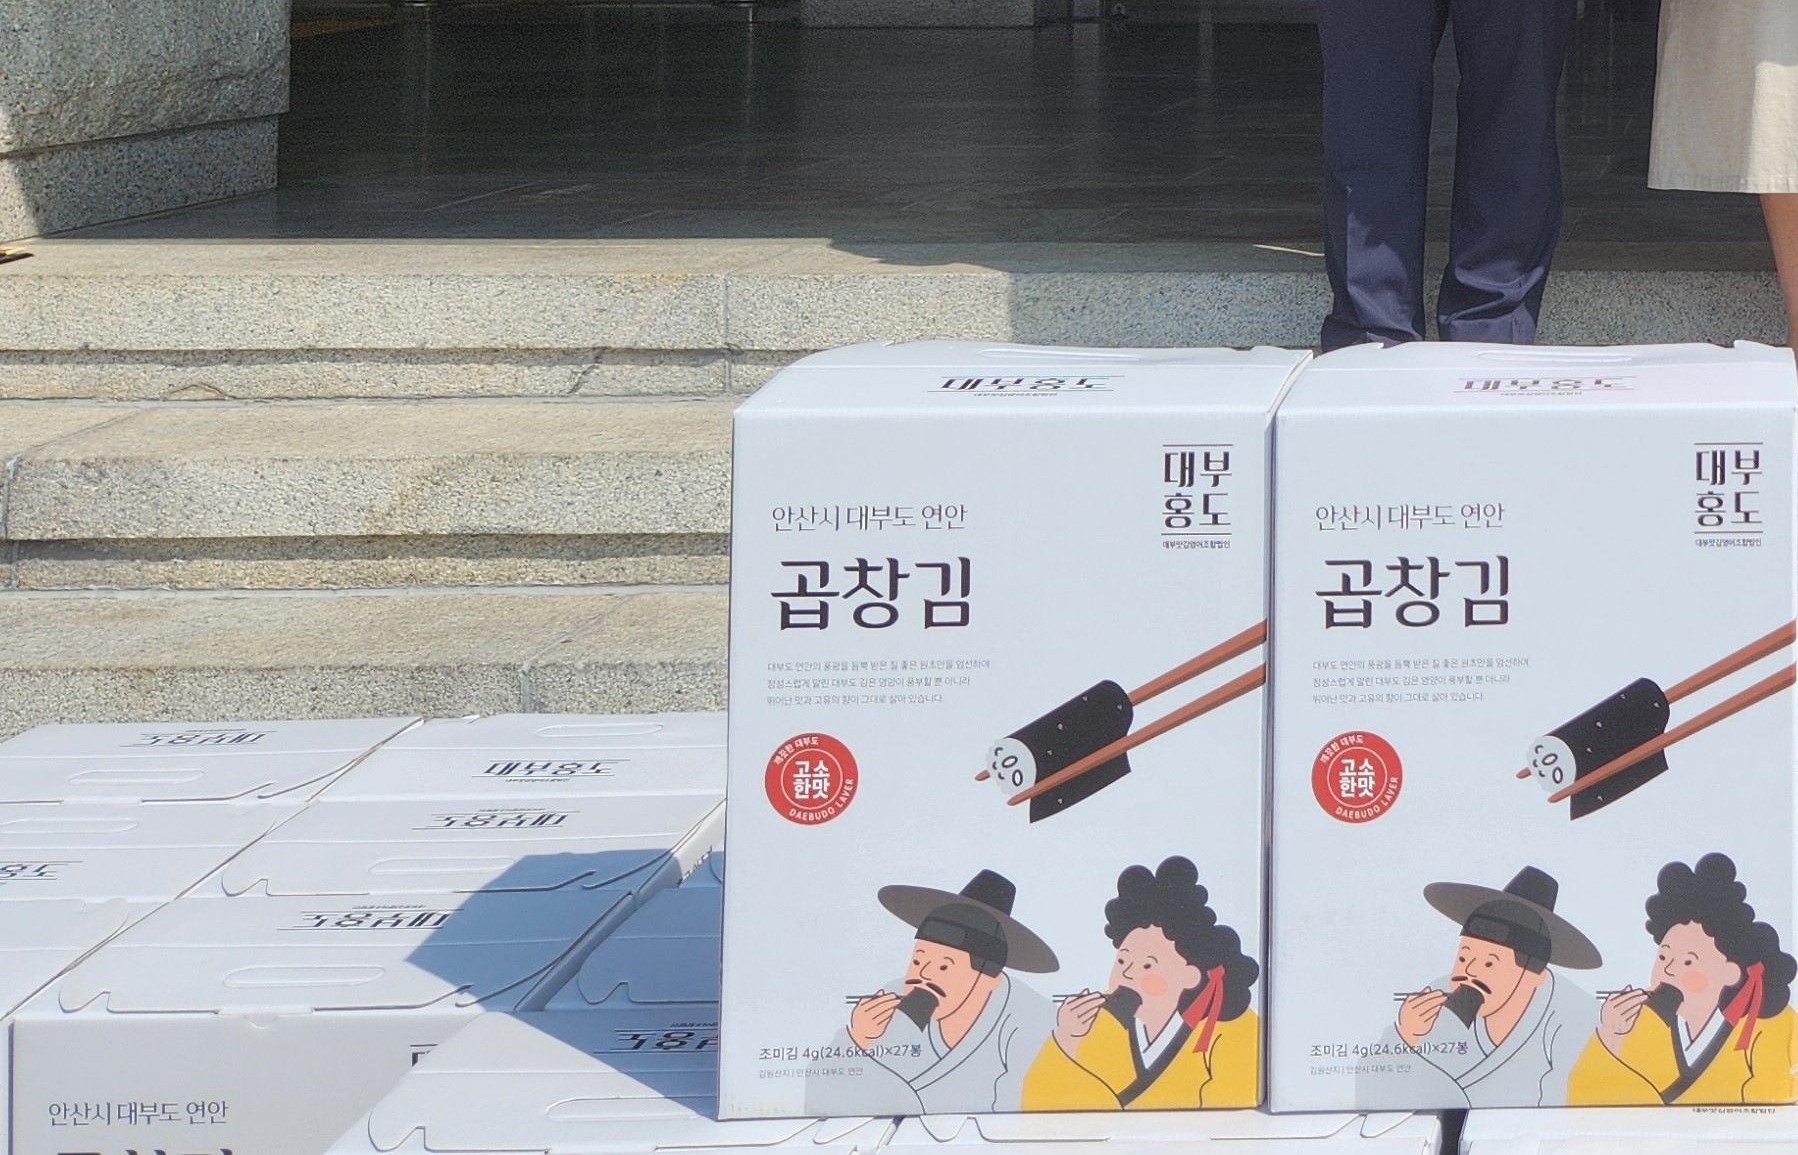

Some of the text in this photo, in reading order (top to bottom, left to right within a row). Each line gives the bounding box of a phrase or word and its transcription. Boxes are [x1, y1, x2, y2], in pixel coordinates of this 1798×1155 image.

[1164, 451, 1232, 487] 대부
[1695, 449, 1763, 486] 대부
[771, 504, 967, 532] 안산시 대부도 연안
[1162, 492, 1231, 528] 홍도
[1315, 502, 1505, 532] 안산시 대부도 연안
[1694, 491, 1763, 528] 홍도
[770, 556, 972, 631] 곱창김
[1314, 554, 1510, 629] 곱창김
[793, 760, 830, 777] 고소
[1339, 759, 1375, 776] 고소
[789, 779, 854, 821] DAEBUDO LAVER
[793, 778, 830, 799] 한맛
[1336, 777, 1398, 819] DAEBUDO LAVER
[1339, 776, 1375, 797] 한맛
[759, 1048, 797, 1060] 조미김
[1310, 1044, 1347, 1057] 조미김
[48, 1100, 229, 1126] 안산시 대부도 연안
